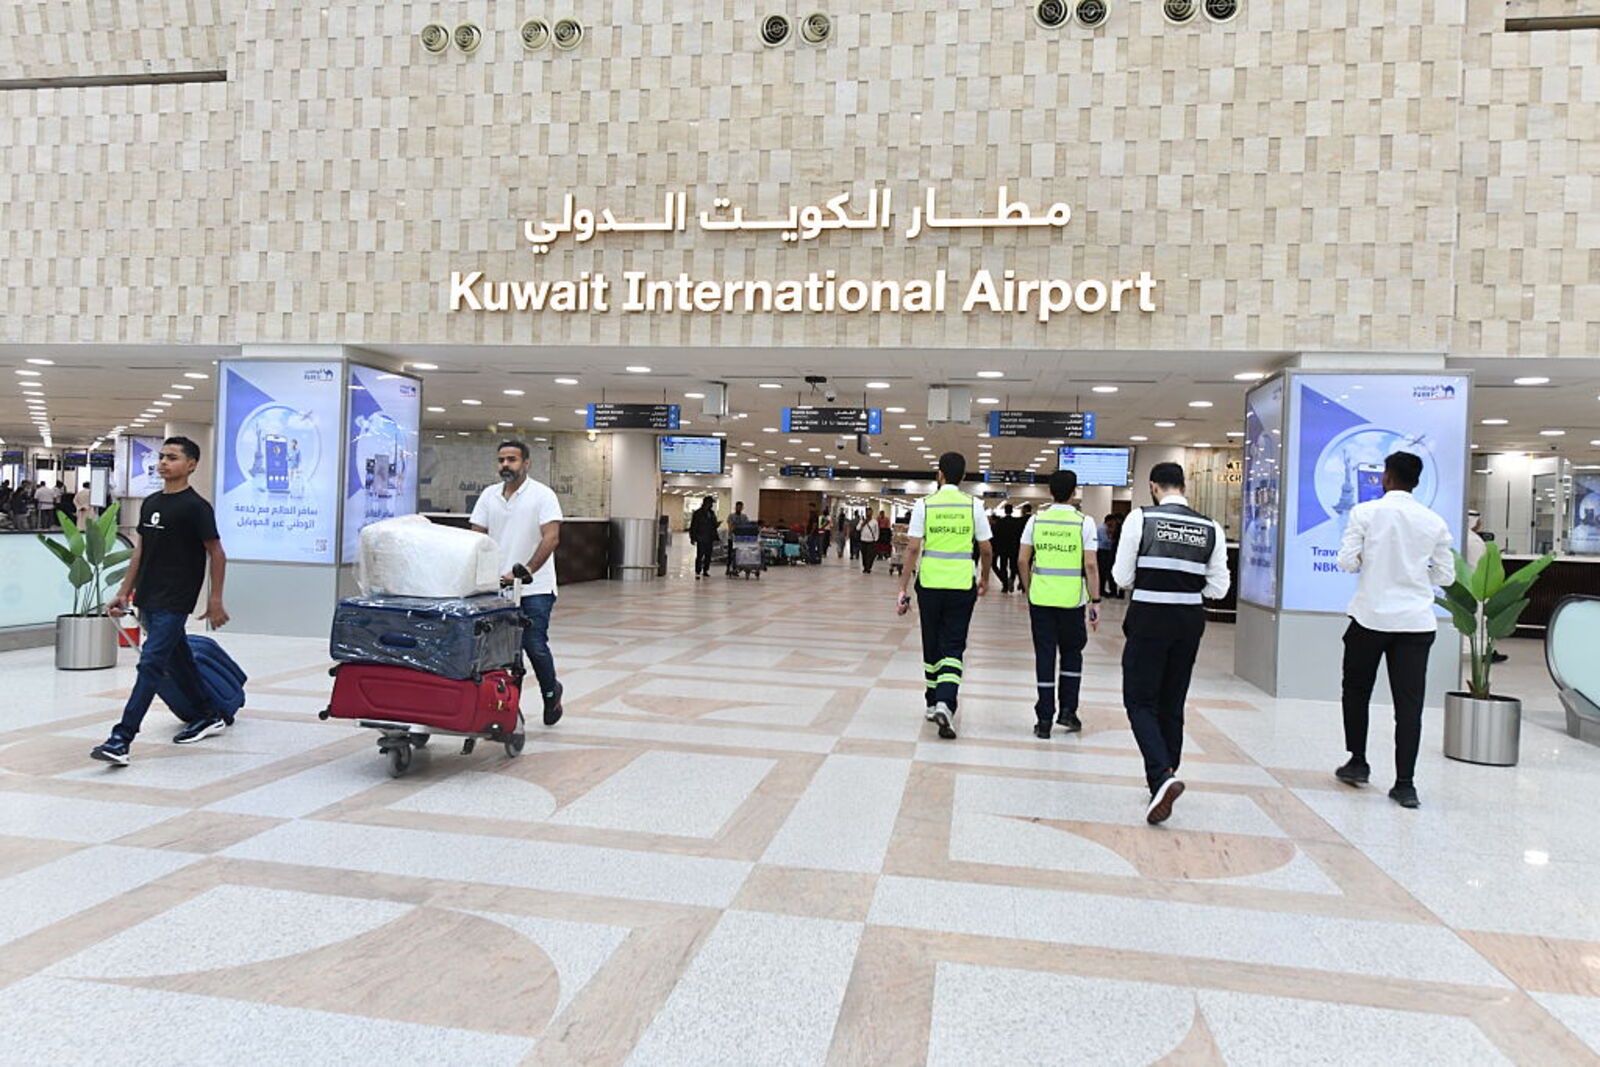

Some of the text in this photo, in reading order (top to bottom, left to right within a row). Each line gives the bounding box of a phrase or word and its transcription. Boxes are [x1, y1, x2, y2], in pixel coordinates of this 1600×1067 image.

[524, 185, 1071, 254] مطار الكويت الدولي
[450, 270, 1157, 323] Kuwait International Airport
[1157, 530, 1206, 547] OPERATIONS
[1313, 562, 1339, 572] NBK
